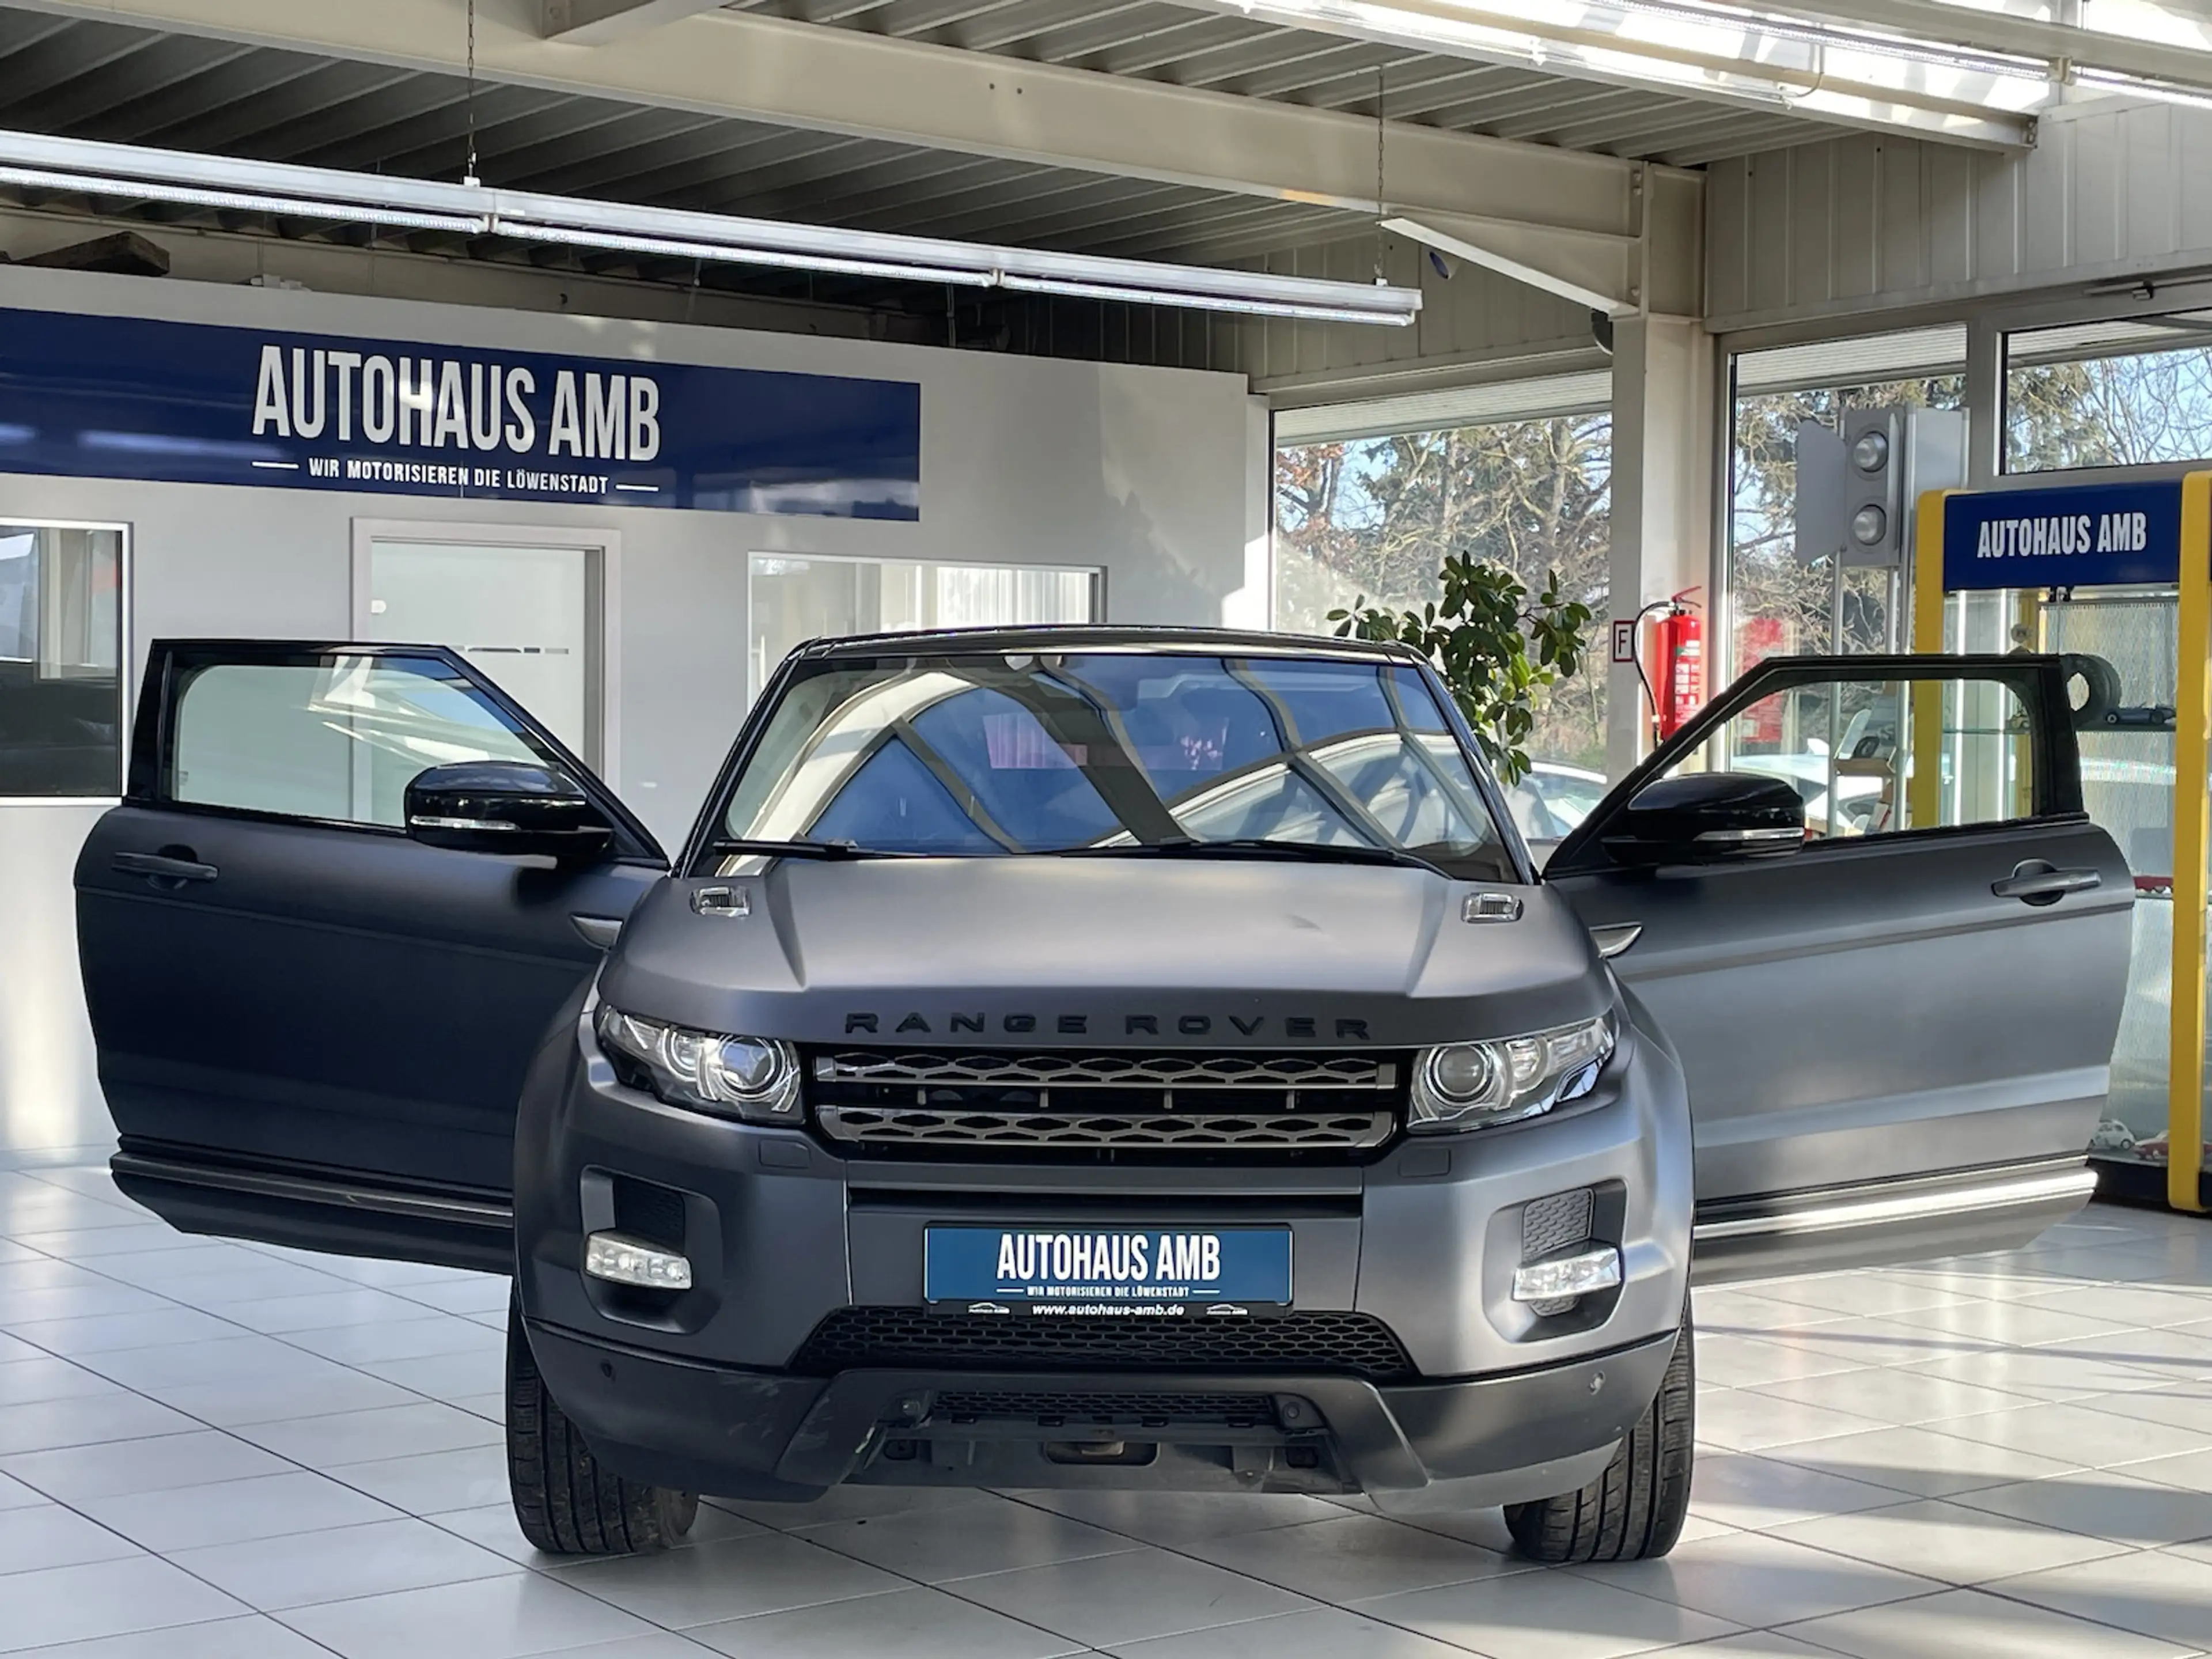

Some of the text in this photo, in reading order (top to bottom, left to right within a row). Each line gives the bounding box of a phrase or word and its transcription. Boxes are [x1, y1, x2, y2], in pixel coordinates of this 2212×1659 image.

[253, 345, 661, 461] AUTOHAUS AMB
[308, 457, 609, 494] WIR MOTORISIEREN DIE LÖWENSTADT
[1977, 512, 2147, 558] AUTOHAUS AMB
[1618, 629, 1628, 654] F
[844, 1012, 1371, 1040] RANGE ROVER
[997, 1233, 1221, 1281] AUTOHAUS AMB
[1027, 1286, 1045, 1296] WIR
[1114, 1286, 1130, 1297] DIE
[1032, 1303, 1184, 1316] www.autohaus-amb.de
